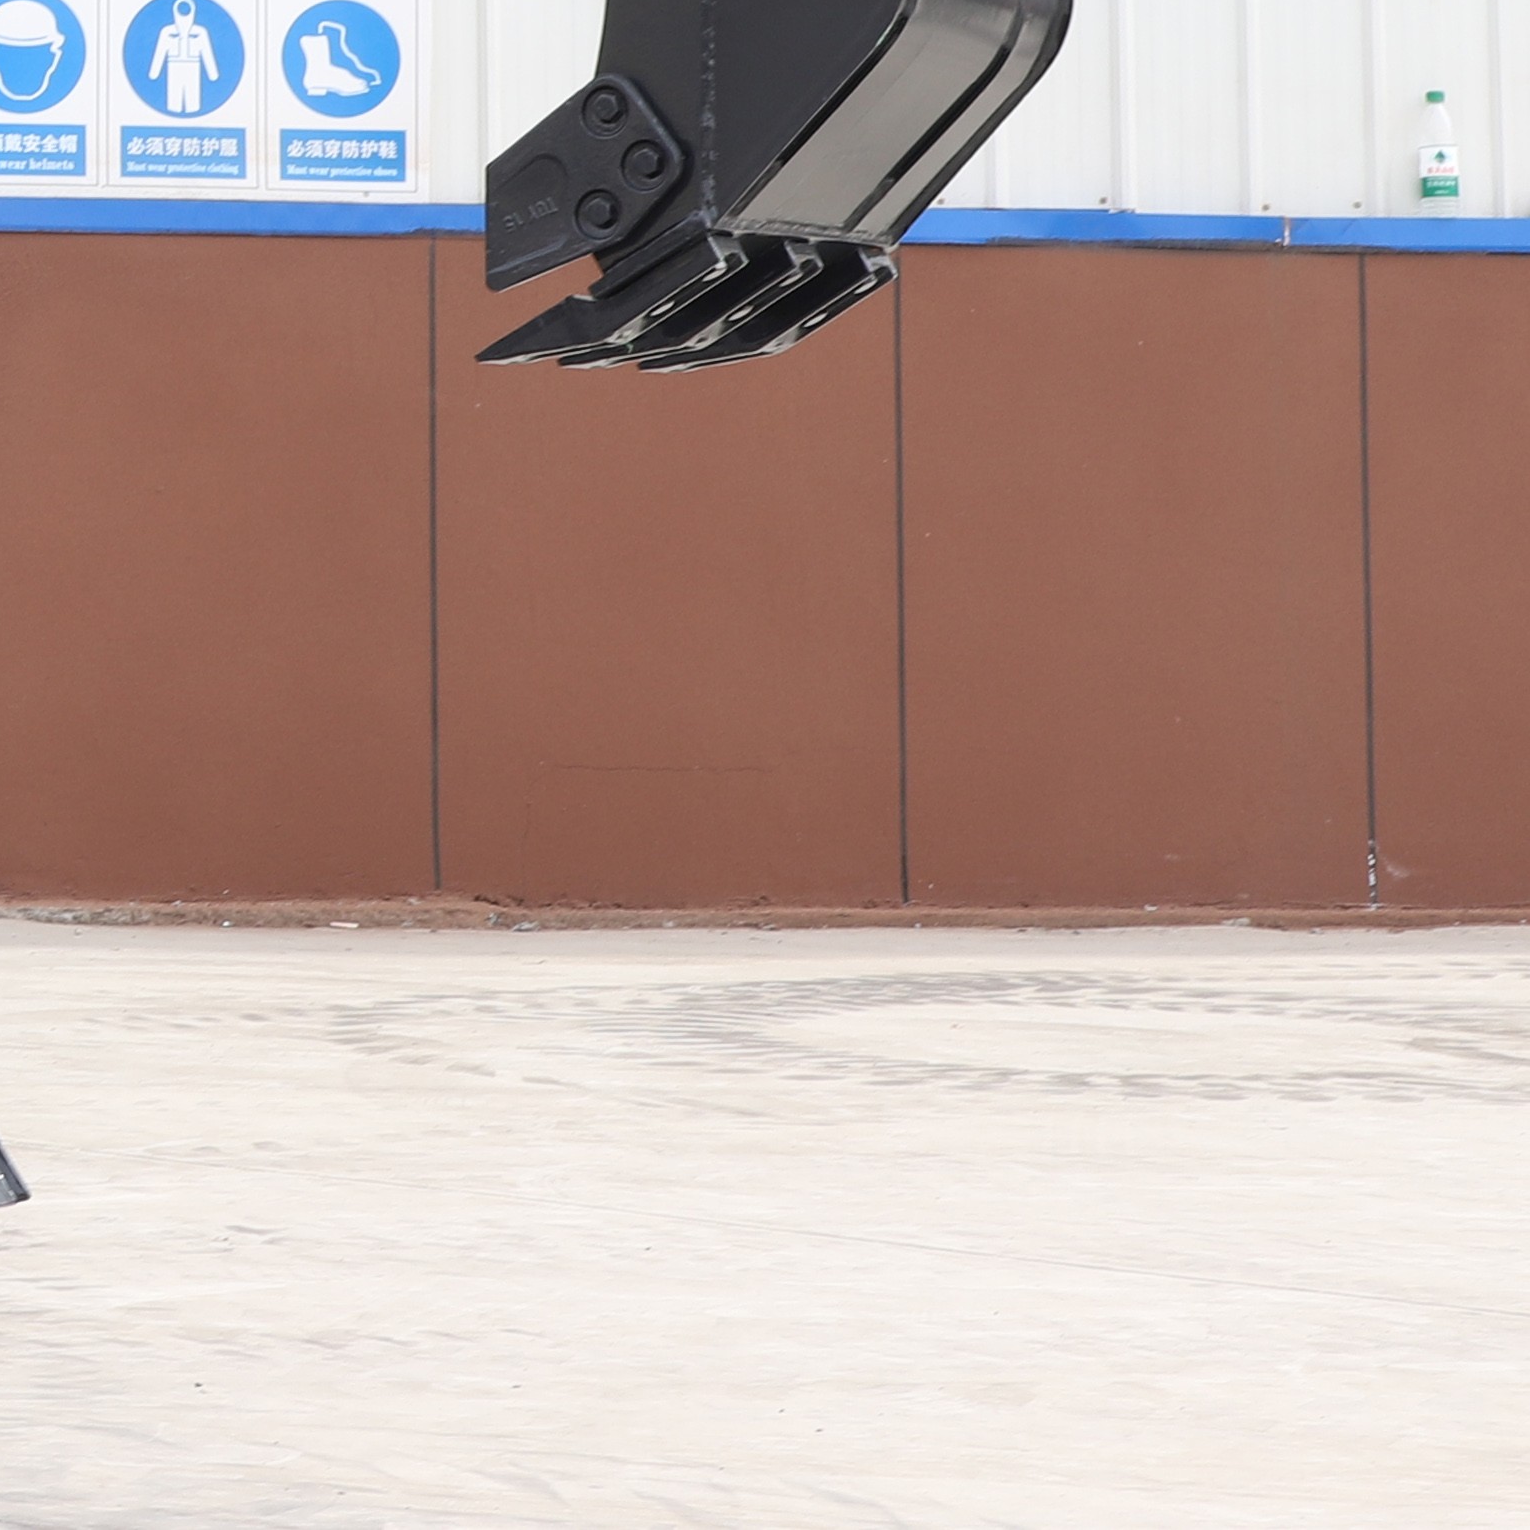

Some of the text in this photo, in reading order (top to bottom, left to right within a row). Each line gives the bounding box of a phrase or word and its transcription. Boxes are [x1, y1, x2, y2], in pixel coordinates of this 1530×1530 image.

[126, 136, 239, 157] 必须穿防护服
[286, 139, 398, 159] 必须穿防护鞋
[0, 159, 27, 170] wear
